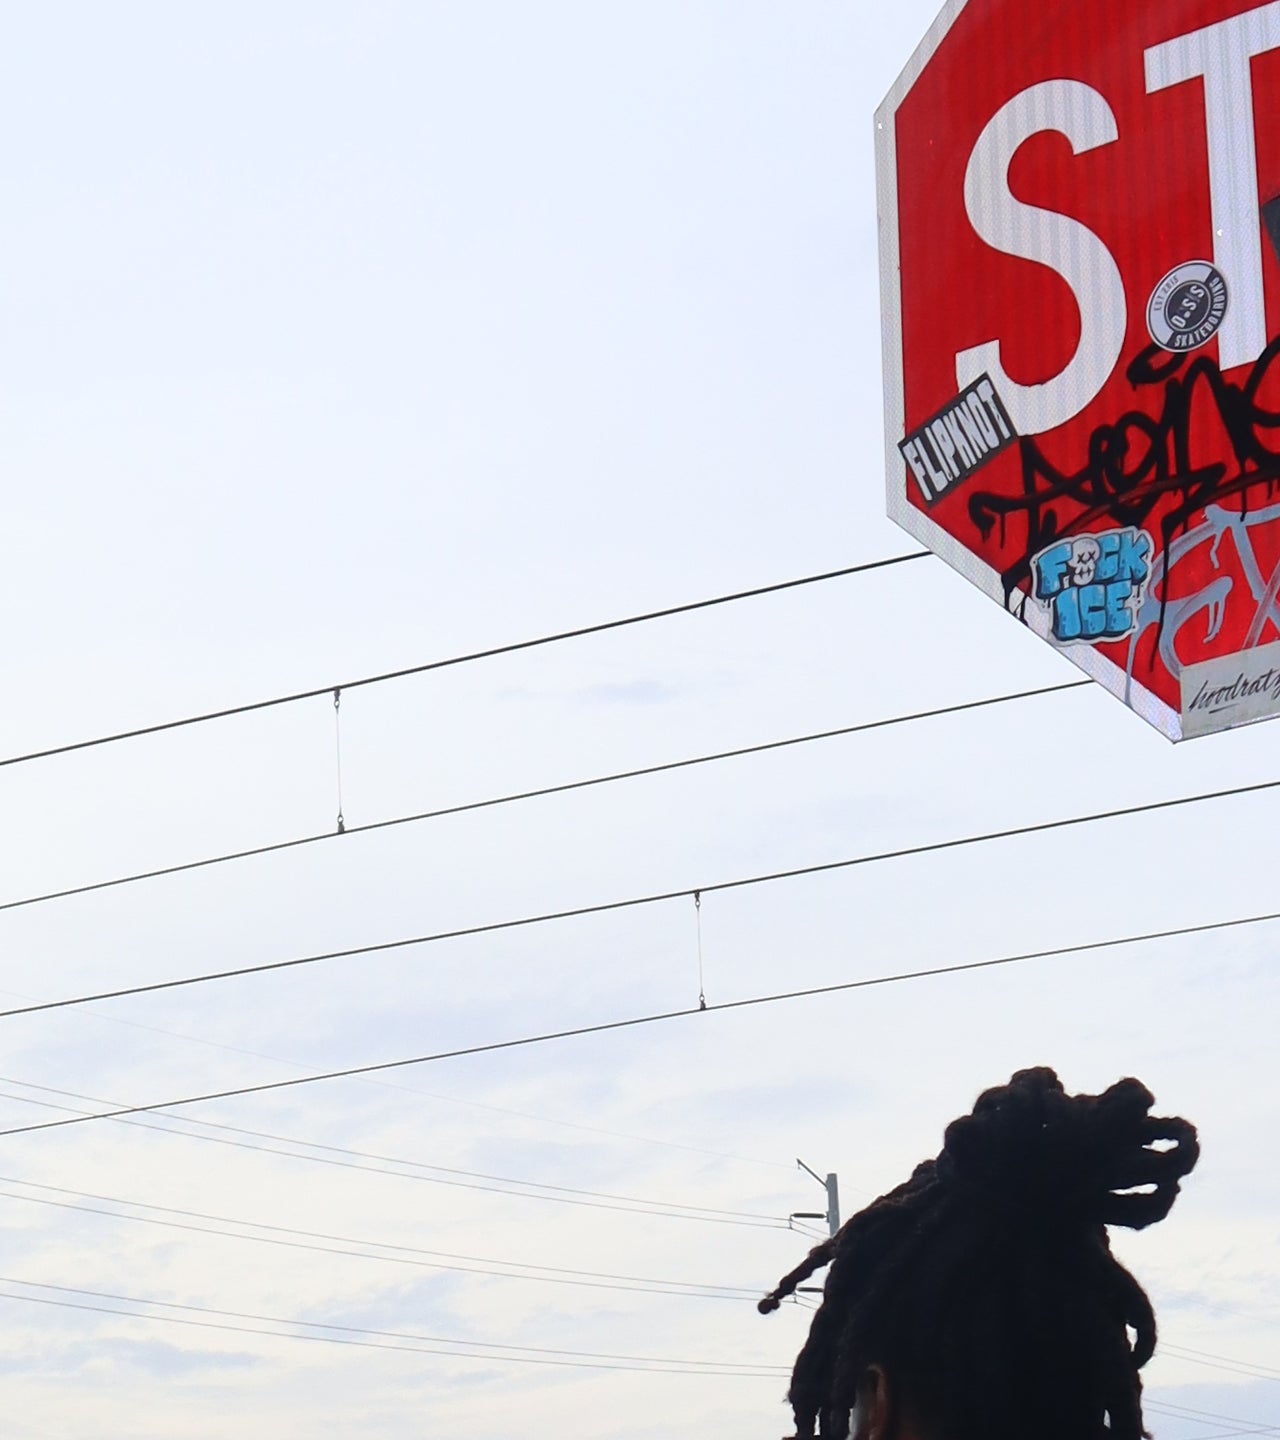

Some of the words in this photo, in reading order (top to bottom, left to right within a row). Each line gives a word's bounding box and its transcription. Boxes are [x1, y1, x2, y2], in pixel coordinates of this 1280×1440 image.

[1174, 277, 1226, 347] SKATEBOARDING
[902, 379, 1011, 501] FLIPKNOT
[1055, 580, 1133, 639] ICE
